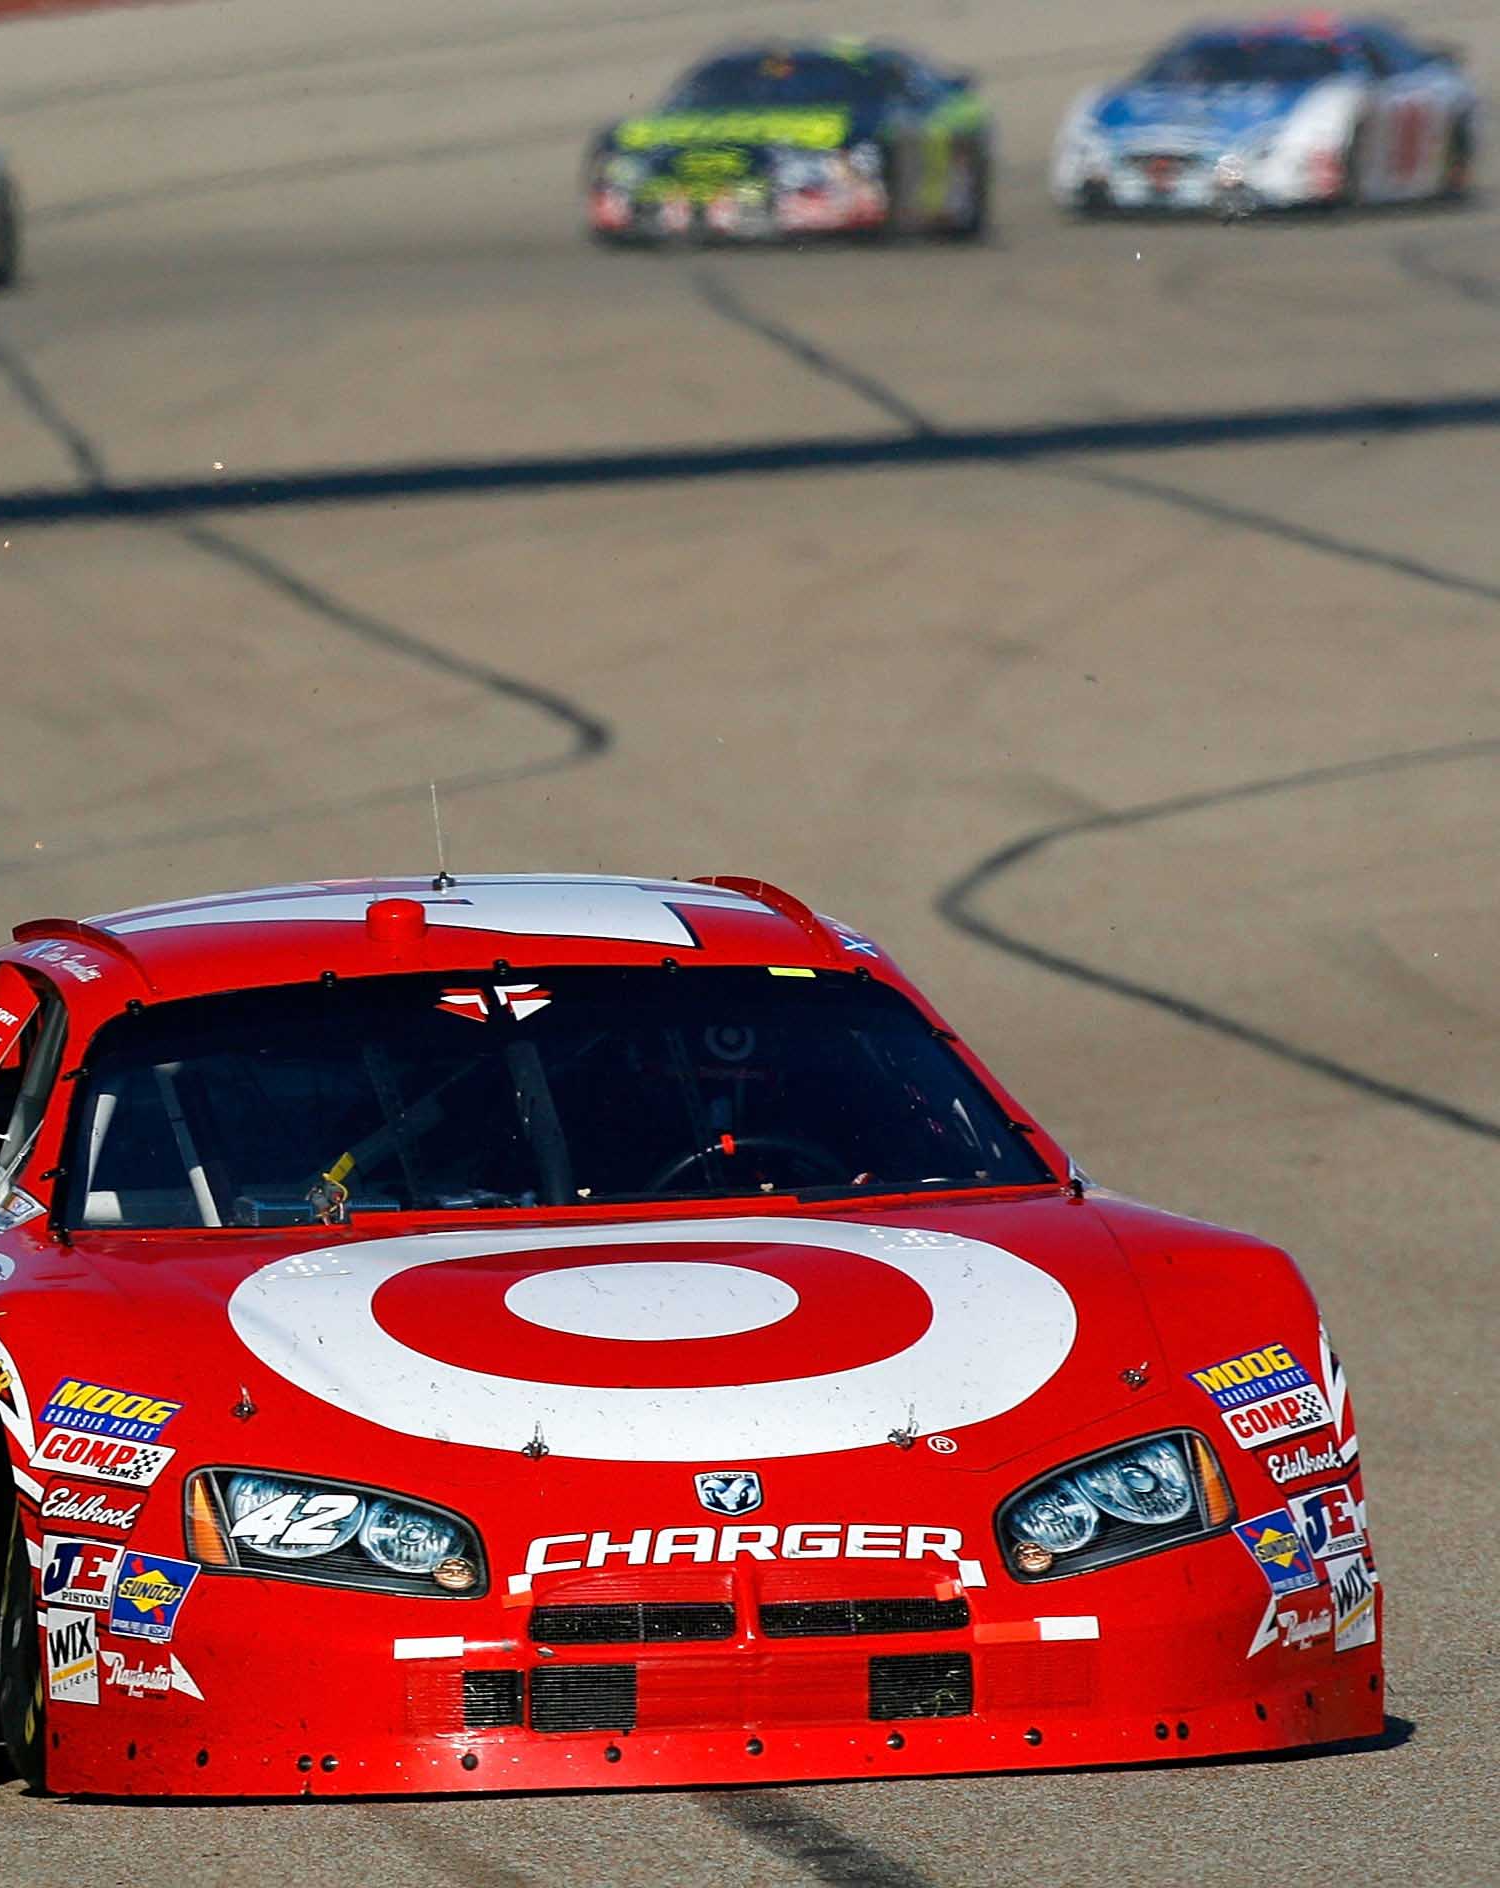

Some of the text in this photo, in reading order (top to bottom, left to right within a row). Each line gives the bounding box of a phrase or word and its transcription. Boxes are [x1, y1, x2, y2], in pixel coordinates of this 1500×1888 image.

[1192, 1344, 1296, 1394] MOOG
[44, 1408, 157, 1440] CHASSIS PARTS
[49, 1380, 184, 1425] MOOG
[1230, 1396, 1300, 1439] COMP
[1288, 1412, 1322, 1429] CAMS
[42, 1433, 138, 1468] COMP
[1267, 1440, 1342, 1484] Edelbrock
[97, 1464, 145, 1481] CAMS
[41, 1487, 142, 1530] Edelbrock
[228, 1494, 360, 1546] 42
[1303, 1489, 1356, 1555] JE
[44, 1542, 119, 1597] JE
[524, 1523, 964, 1576] CHARGER
[61, 1590, 110, 1607] PISTONS
[119, 1578, 183, 1604] SUNOCO
[1333, 1557, 1373, 1619] WIX
[49, 1616, 93, 1669] WIX
[51, 1670, 99, 1695] FILTERS
